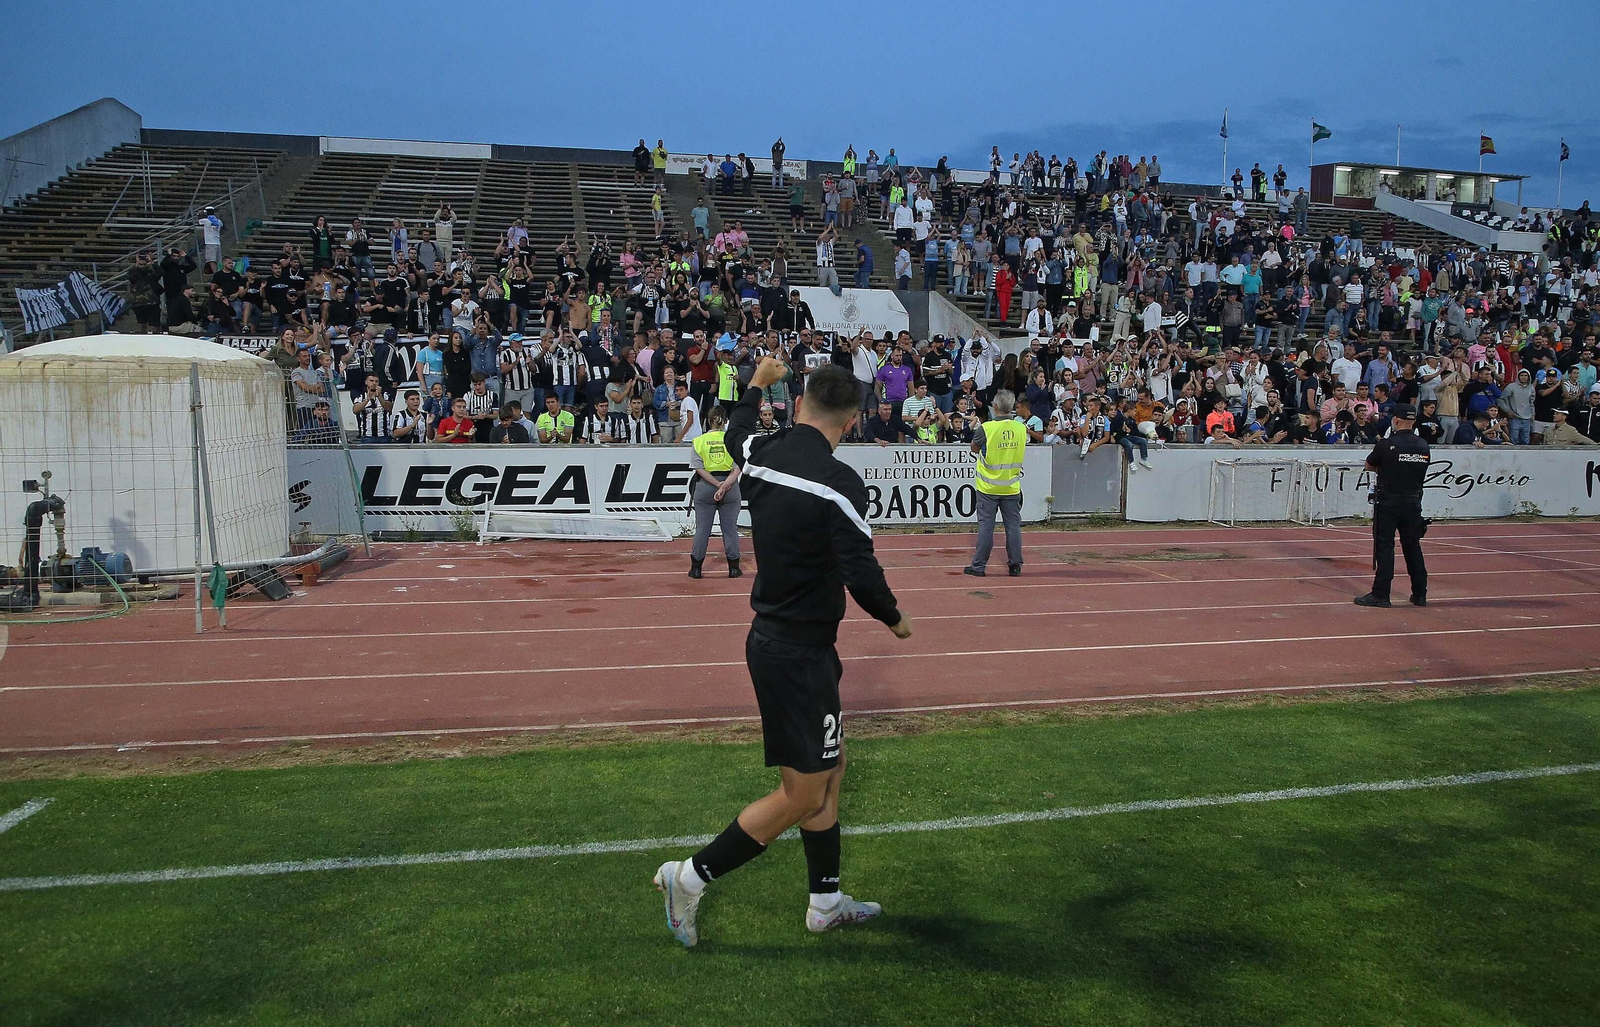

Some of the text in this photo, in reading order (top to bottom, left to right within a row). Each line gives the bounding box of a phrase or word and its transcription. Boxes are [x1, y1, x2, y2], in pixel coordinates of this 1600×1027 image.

[893, 450, 978, 465] MUEBLES
[356, 464, 592, 507] LEGEA
[604, 463, 692, 503] LE
